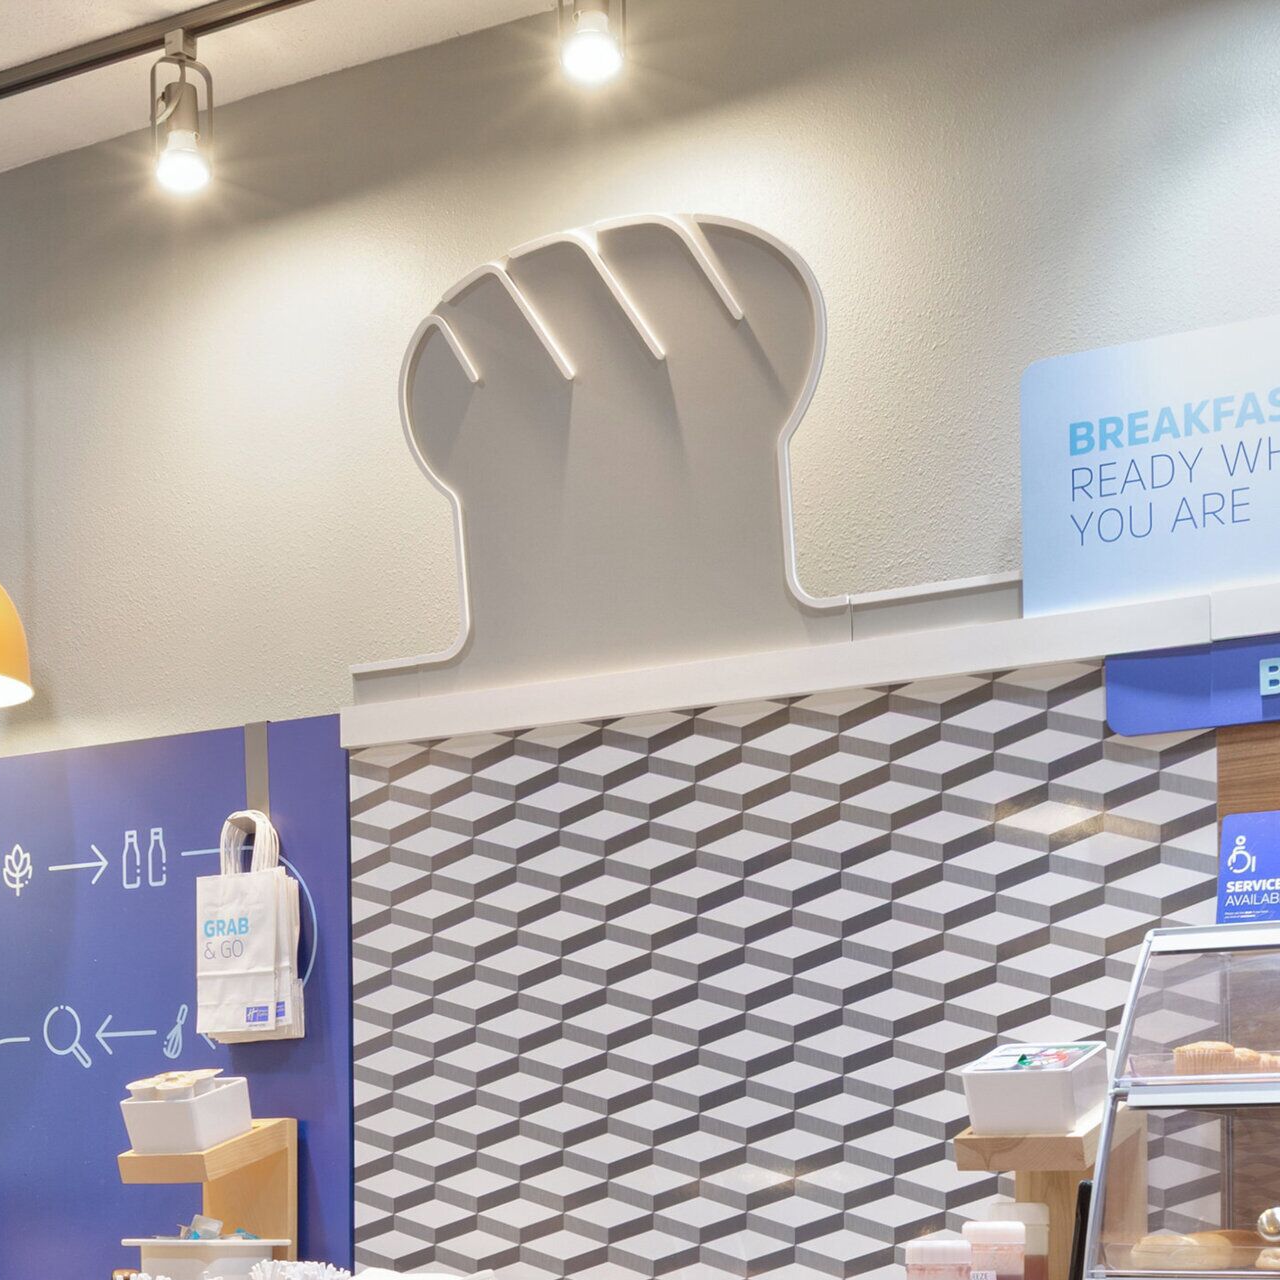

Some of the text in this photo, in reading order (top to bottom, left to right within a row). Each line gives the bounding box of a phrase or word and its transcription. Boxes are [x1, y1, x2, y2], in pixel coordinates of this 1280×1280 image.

[1071, 447, 1202, 502] READY
[1070, 486, 1252, 546] YOU ARE
[204, 917, 250, 938] GRAB
[204, 939, 244, 960] & GO
